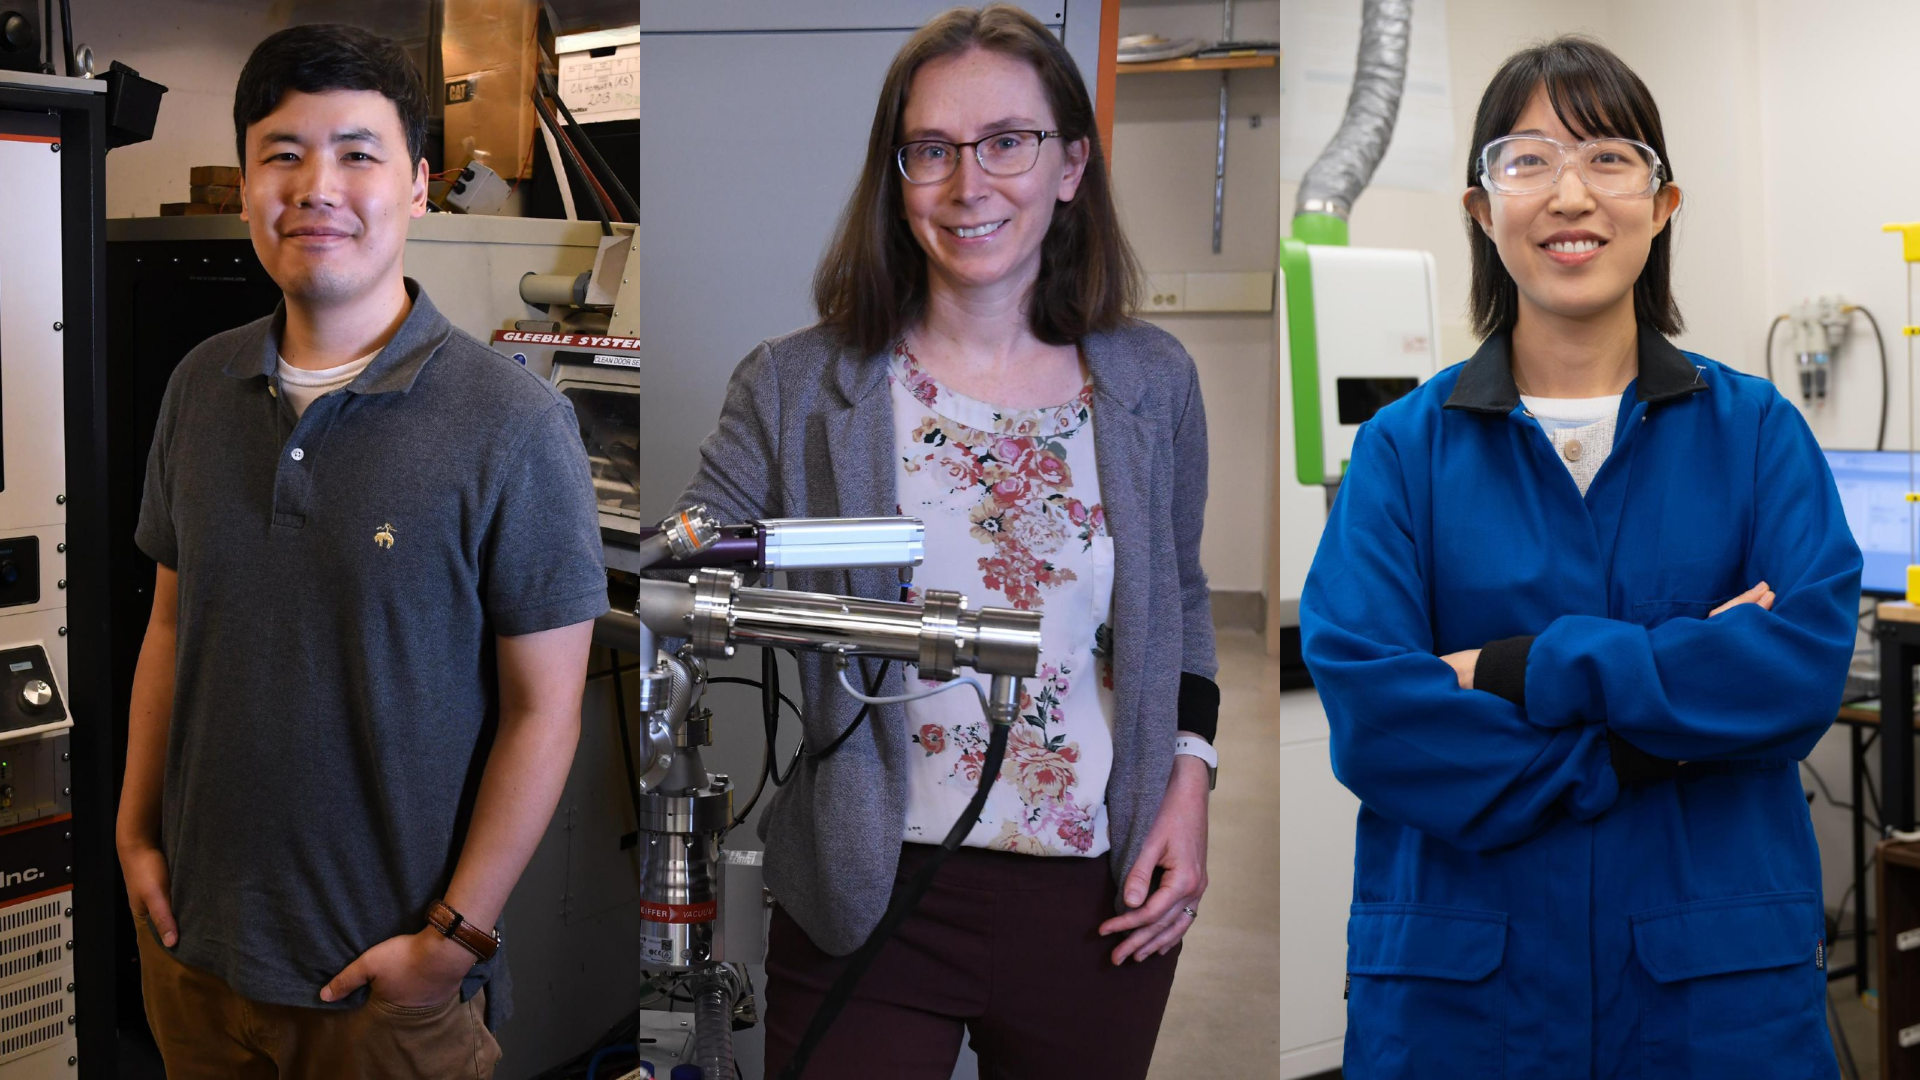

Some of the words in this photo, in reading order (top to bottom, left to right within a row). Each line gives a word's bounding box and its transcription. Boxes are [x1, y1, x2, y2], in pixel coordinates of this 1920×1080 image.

[449, 83, 466, 101] CAT
[503, 332, 573, 344] GLEEBLE
[613, 357, 631, 365] DOOR
[0, 867, 45, 888] Inc.
[682, 907, 714, 918] VACUUM
